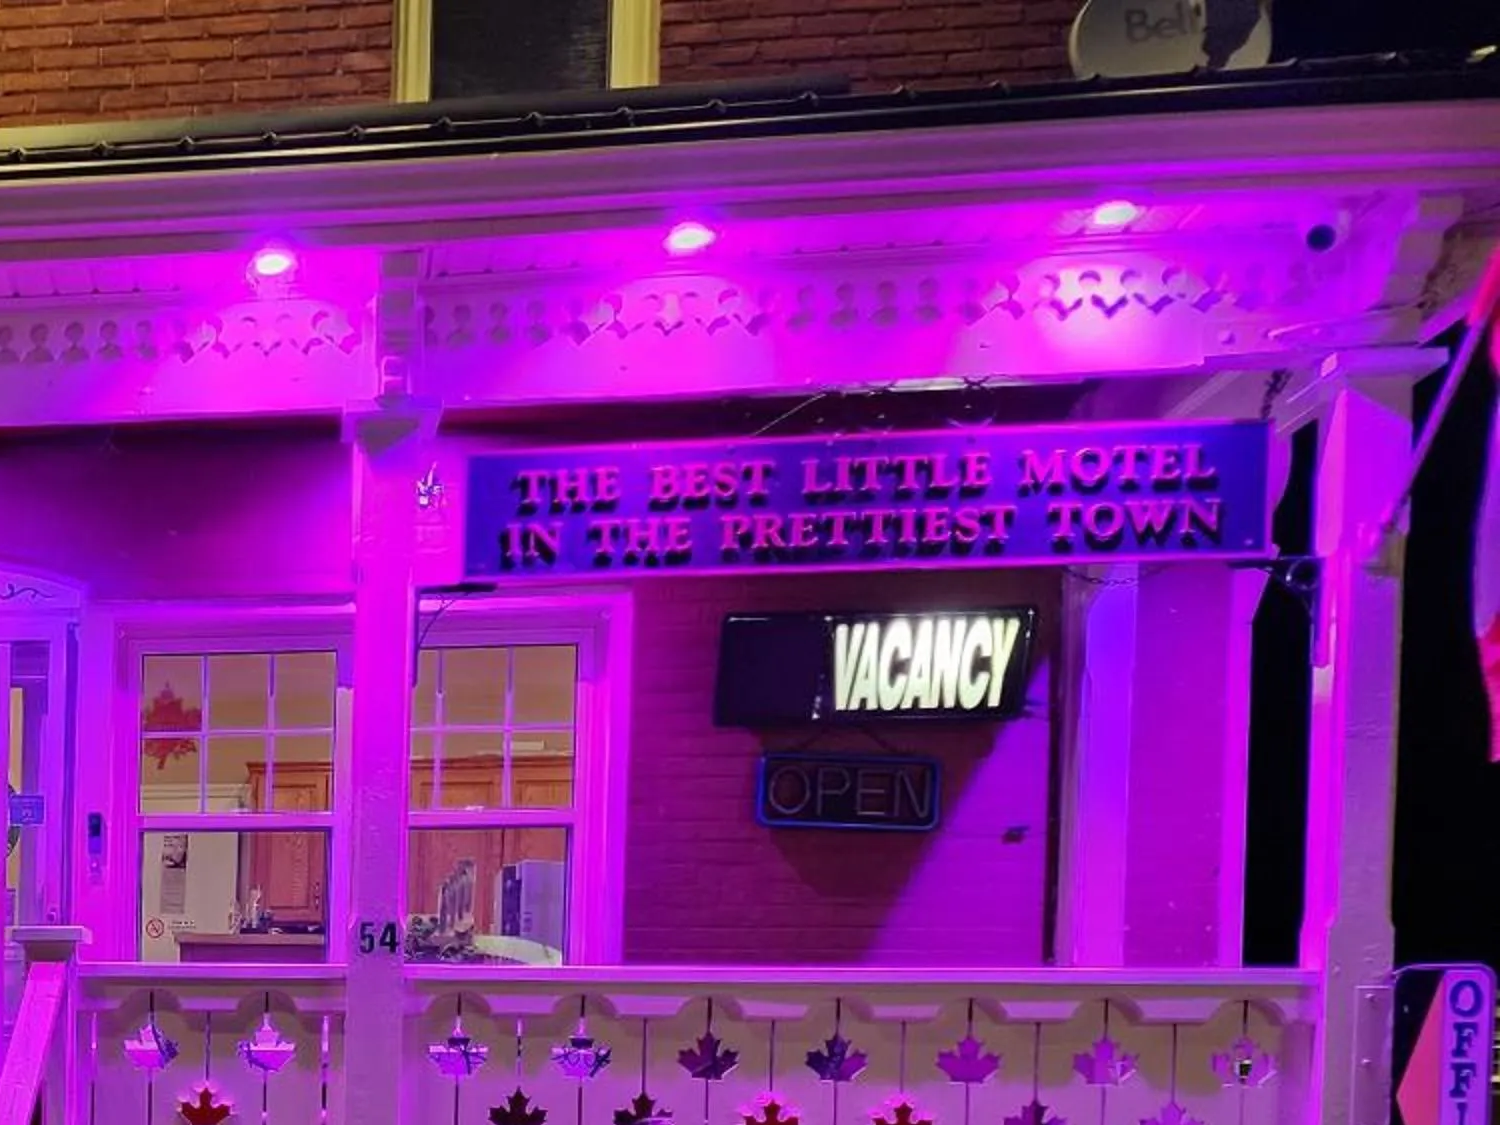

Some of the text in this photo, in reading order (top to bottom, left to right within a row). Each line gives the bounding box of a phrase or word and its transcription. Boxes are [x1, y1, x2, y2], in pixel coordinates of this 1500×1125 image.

[517, 444, 1217, 504] THE BEST LITTLE MOTEL
[504, 498, 1221, 558] IN THE PRETTIEST TOWN
[834, 616, 1020, 711] VACANCY
[768, 764, 933, 820] OPEN
[359, 920, 399, 955] 54
